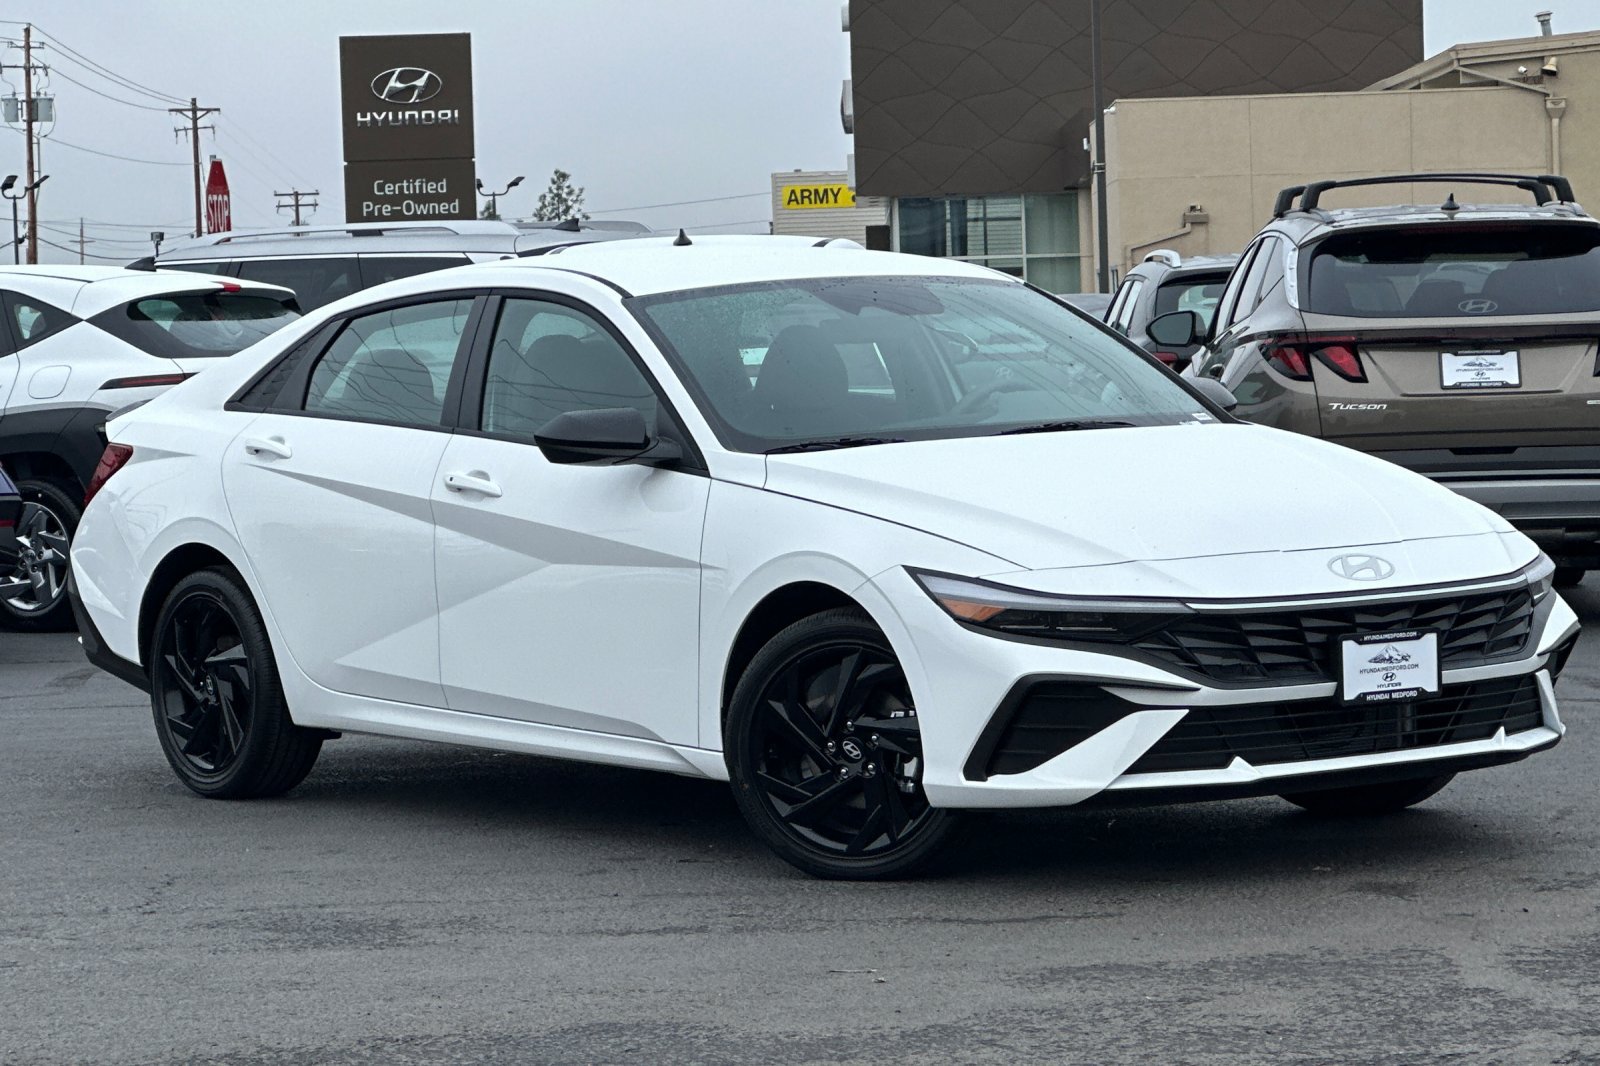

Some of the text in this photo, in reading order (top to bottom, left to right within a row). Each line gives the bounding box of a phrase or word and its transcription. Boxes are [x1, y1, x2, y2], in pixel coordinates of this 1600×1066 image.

[356, 109, 459, 127] HYUNDAI
[373, 178, 447, 195] Certified
[787, 187, 842, 205] ARMY
[207, 194, 229, 233] STOP
[362, 198, 459, 216] Pre-Owned
[1363, 631, 1417, 641] HYUNDAIMEDFORD.COM
[1360, 663, 1419, 674] HYUNDAIMEDFORD.COM
[1366, 690, 1418, 701] HYUNDAI MEDFORD
